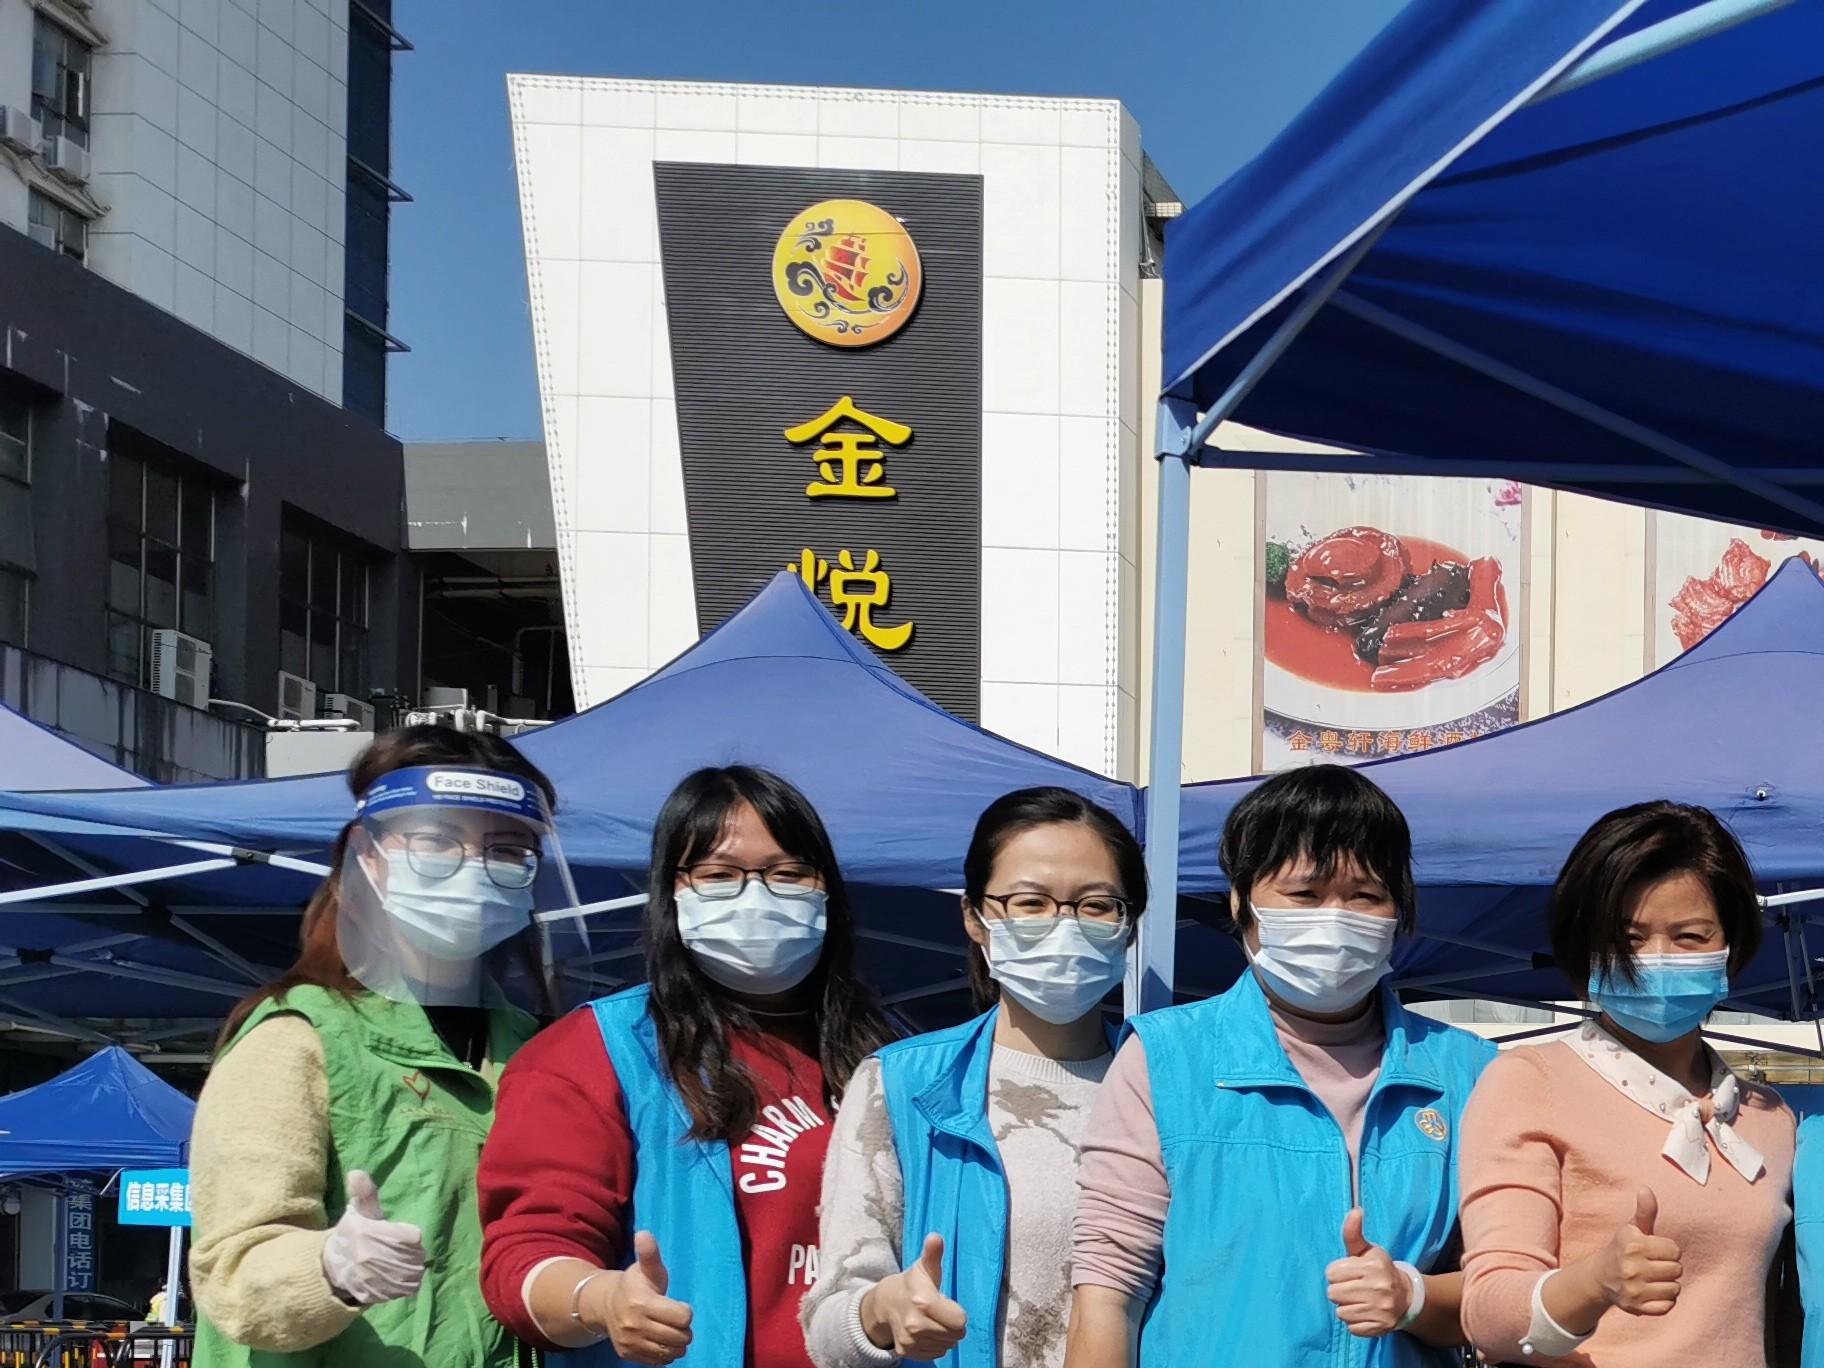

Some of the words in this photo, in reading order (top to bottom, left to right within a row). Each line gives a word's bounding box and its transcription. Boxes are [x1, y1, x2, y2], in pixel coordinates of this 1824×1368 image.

[1286, 729, 1480, 752] 金粤轩海鲜酒
[434, 775, 471, 789] Face
[476, 779, 520, 797] Shield
[738, 1095, 825, 1194] CHARM
[126, 1181, 192, 1212] 信息采集
